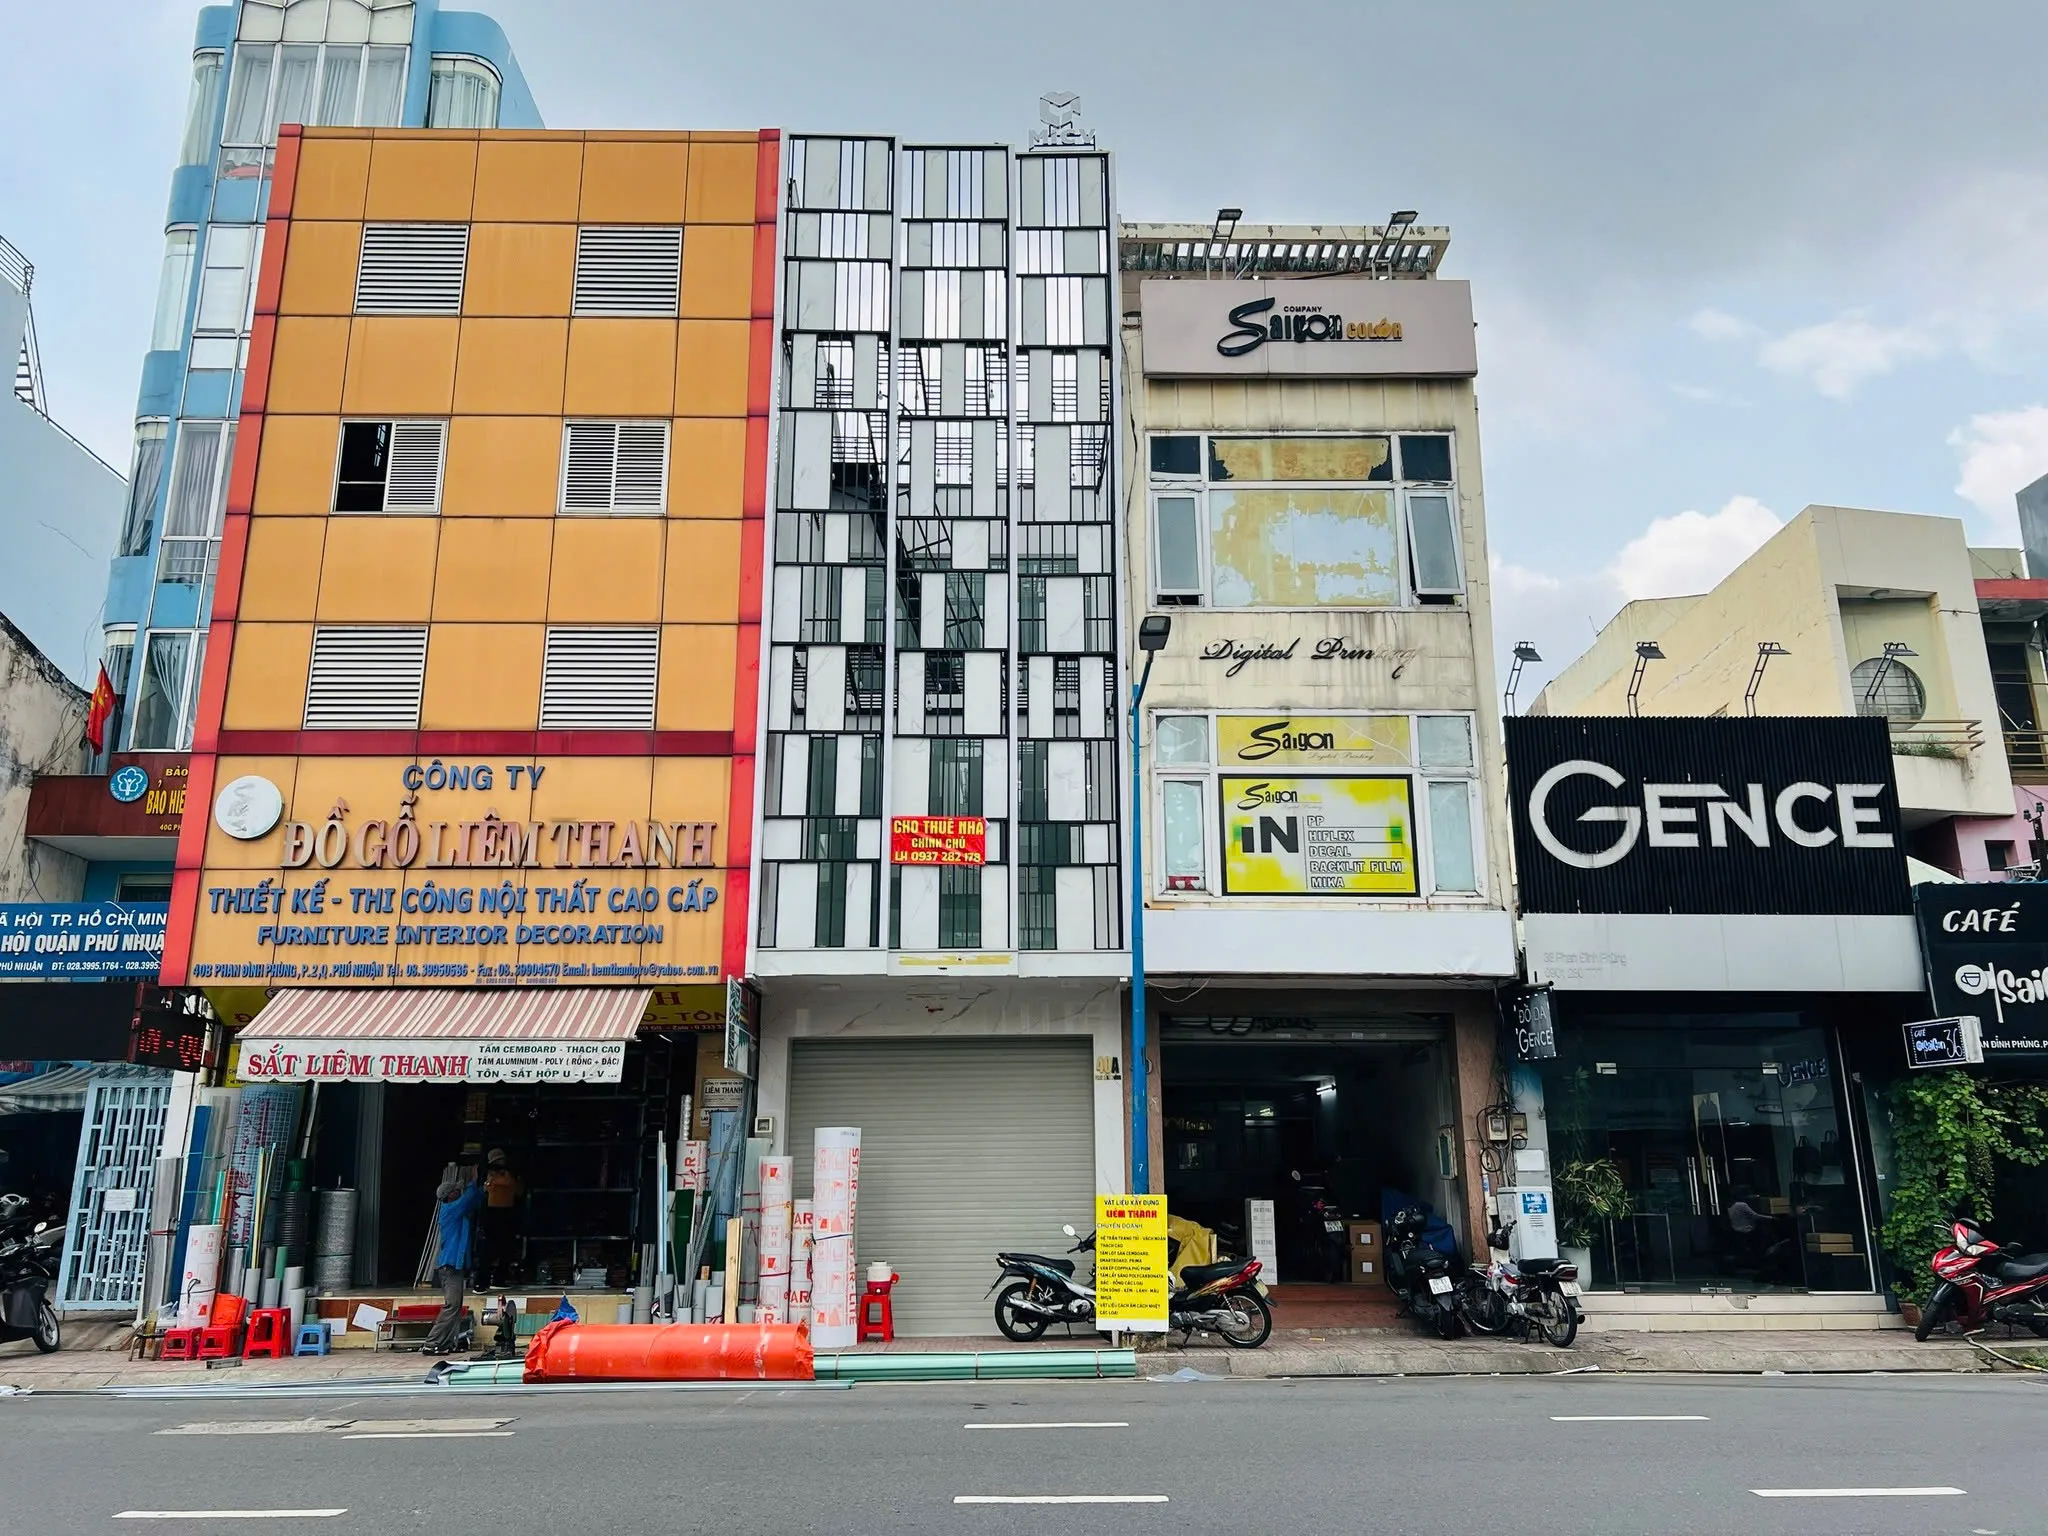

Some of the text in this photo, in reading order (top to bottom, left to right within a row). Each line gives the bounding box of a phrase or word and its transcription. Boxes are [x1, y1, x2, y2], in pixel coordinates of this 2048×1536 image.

[1284, 305, 1322, 313] COMPANY
[1217, 297, 1403, 357] Saigon COLOR
[1199, 637, 1301, 678] Digital
[1238, 721, 1335, 761] Saigon
[403, 759, 546, 791] CÔNG TY
[1237, 782, 1299, 811] Saigon
[1306, 815, 1325, 827] PP
[1528, 759, 1895, 869] GENCE
[280, 793, 718, 869] ĐỒ GỖ LIÊM THANH
[893, 818, 985, 836] CHO THUÊ NHÀ
[1307, 830, 1355, 842] HIFLEX
[895, 851, 908, 861] LH
[911, 851, 938, 862] 0937
[1308, 845, 1352, 858] DECAL
[1309, 861, 1403, 873] BACKLIT FILM
[1310, 876, 1345, 889] MIKA
[208, 877, 286, 914] THIẾT
[291, 877, 331, 914] KẾ
[349, 886, 396, 914] THI
[402, 879, 473, 914] CÔNG
[478, 879, 528, 919] NỘI
[535, 877, 602, 914] THẤT
[607, 886, 660, 913] CAO
[667, 877, 719, 913] CẤP
[14, 911, 43, 930] HỘI
[51, 913, 73, 927] TP.
[77, 908, 102, 927] HỒ
[105, 909, 135, 927] CHÍ
[1942, 901, 2022, 933] CAFÉ
[2, 930, 32, 956] HỘI
[34, 930, 81, 955] QUẬN
[84, 929, 120, 952] PHÚ
[257, 923, 664, 946] FURNITURE INTERIOR DECORATION
[52, 961, 65, 971] ĐT:
[66, 961, 119, 971] 028.3995.1764
[214, 963, 240, 977] PHAN
[479, 1042, 621, 1056] TẤM CEMBOARD THẠCH CAO
[1518, 1028, 1554, 1054] GENCE
[1942, 1027, 1963, 1059] 36
[247, 1042, 301, 1077] SẮT
[304, 1048, 372, 1078] LIÊM
[378, 1054, 473, 1078] THANH
[495, 1057, 539, 1066] ALUMINIUM
[545, 1057, 567, 1066] POLY
[476, 1068, 500, 1078] TÔN
[535, 1068, 559, 1080] HỘP
[1128, 1209, 1158, 1218] THANH
